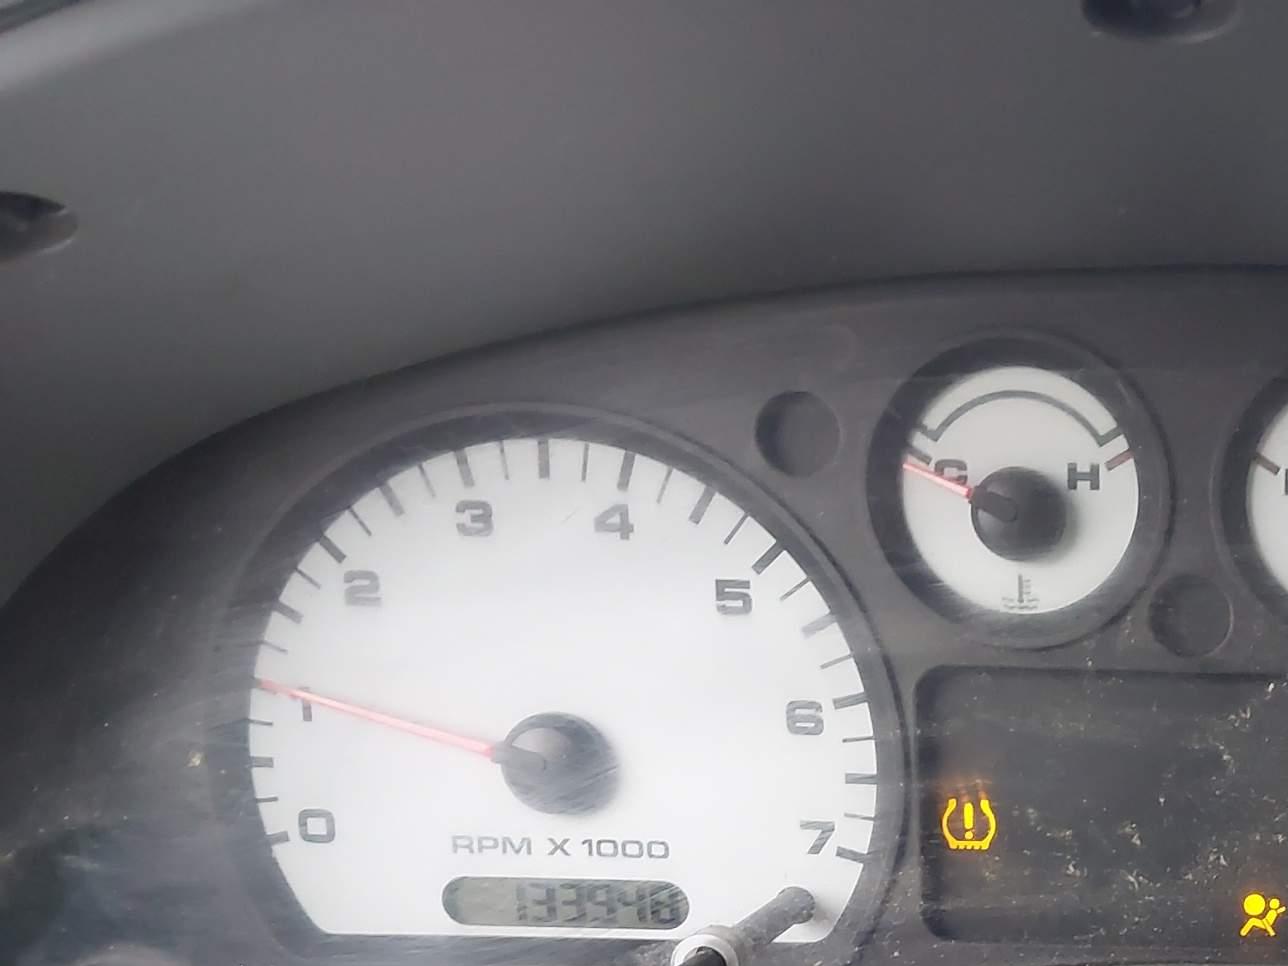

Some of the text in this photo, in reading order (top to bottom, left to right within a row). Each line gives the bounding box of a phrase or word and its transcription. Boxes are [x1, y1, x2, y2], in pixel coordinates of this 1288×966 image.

[1067, 463, 1100, 491] H
[456, 500, 493, 537] 3
[595, 504, 634, 540] 4
[344, 570, 382, 606] 2
[715, 579, 753, 616] 5
[786, 700, 825, 736] 6
[298, 809, 335, 844] 0
[800, 821, 835, 855] 7
[452, 836, 670, 859] RPM X 1000
